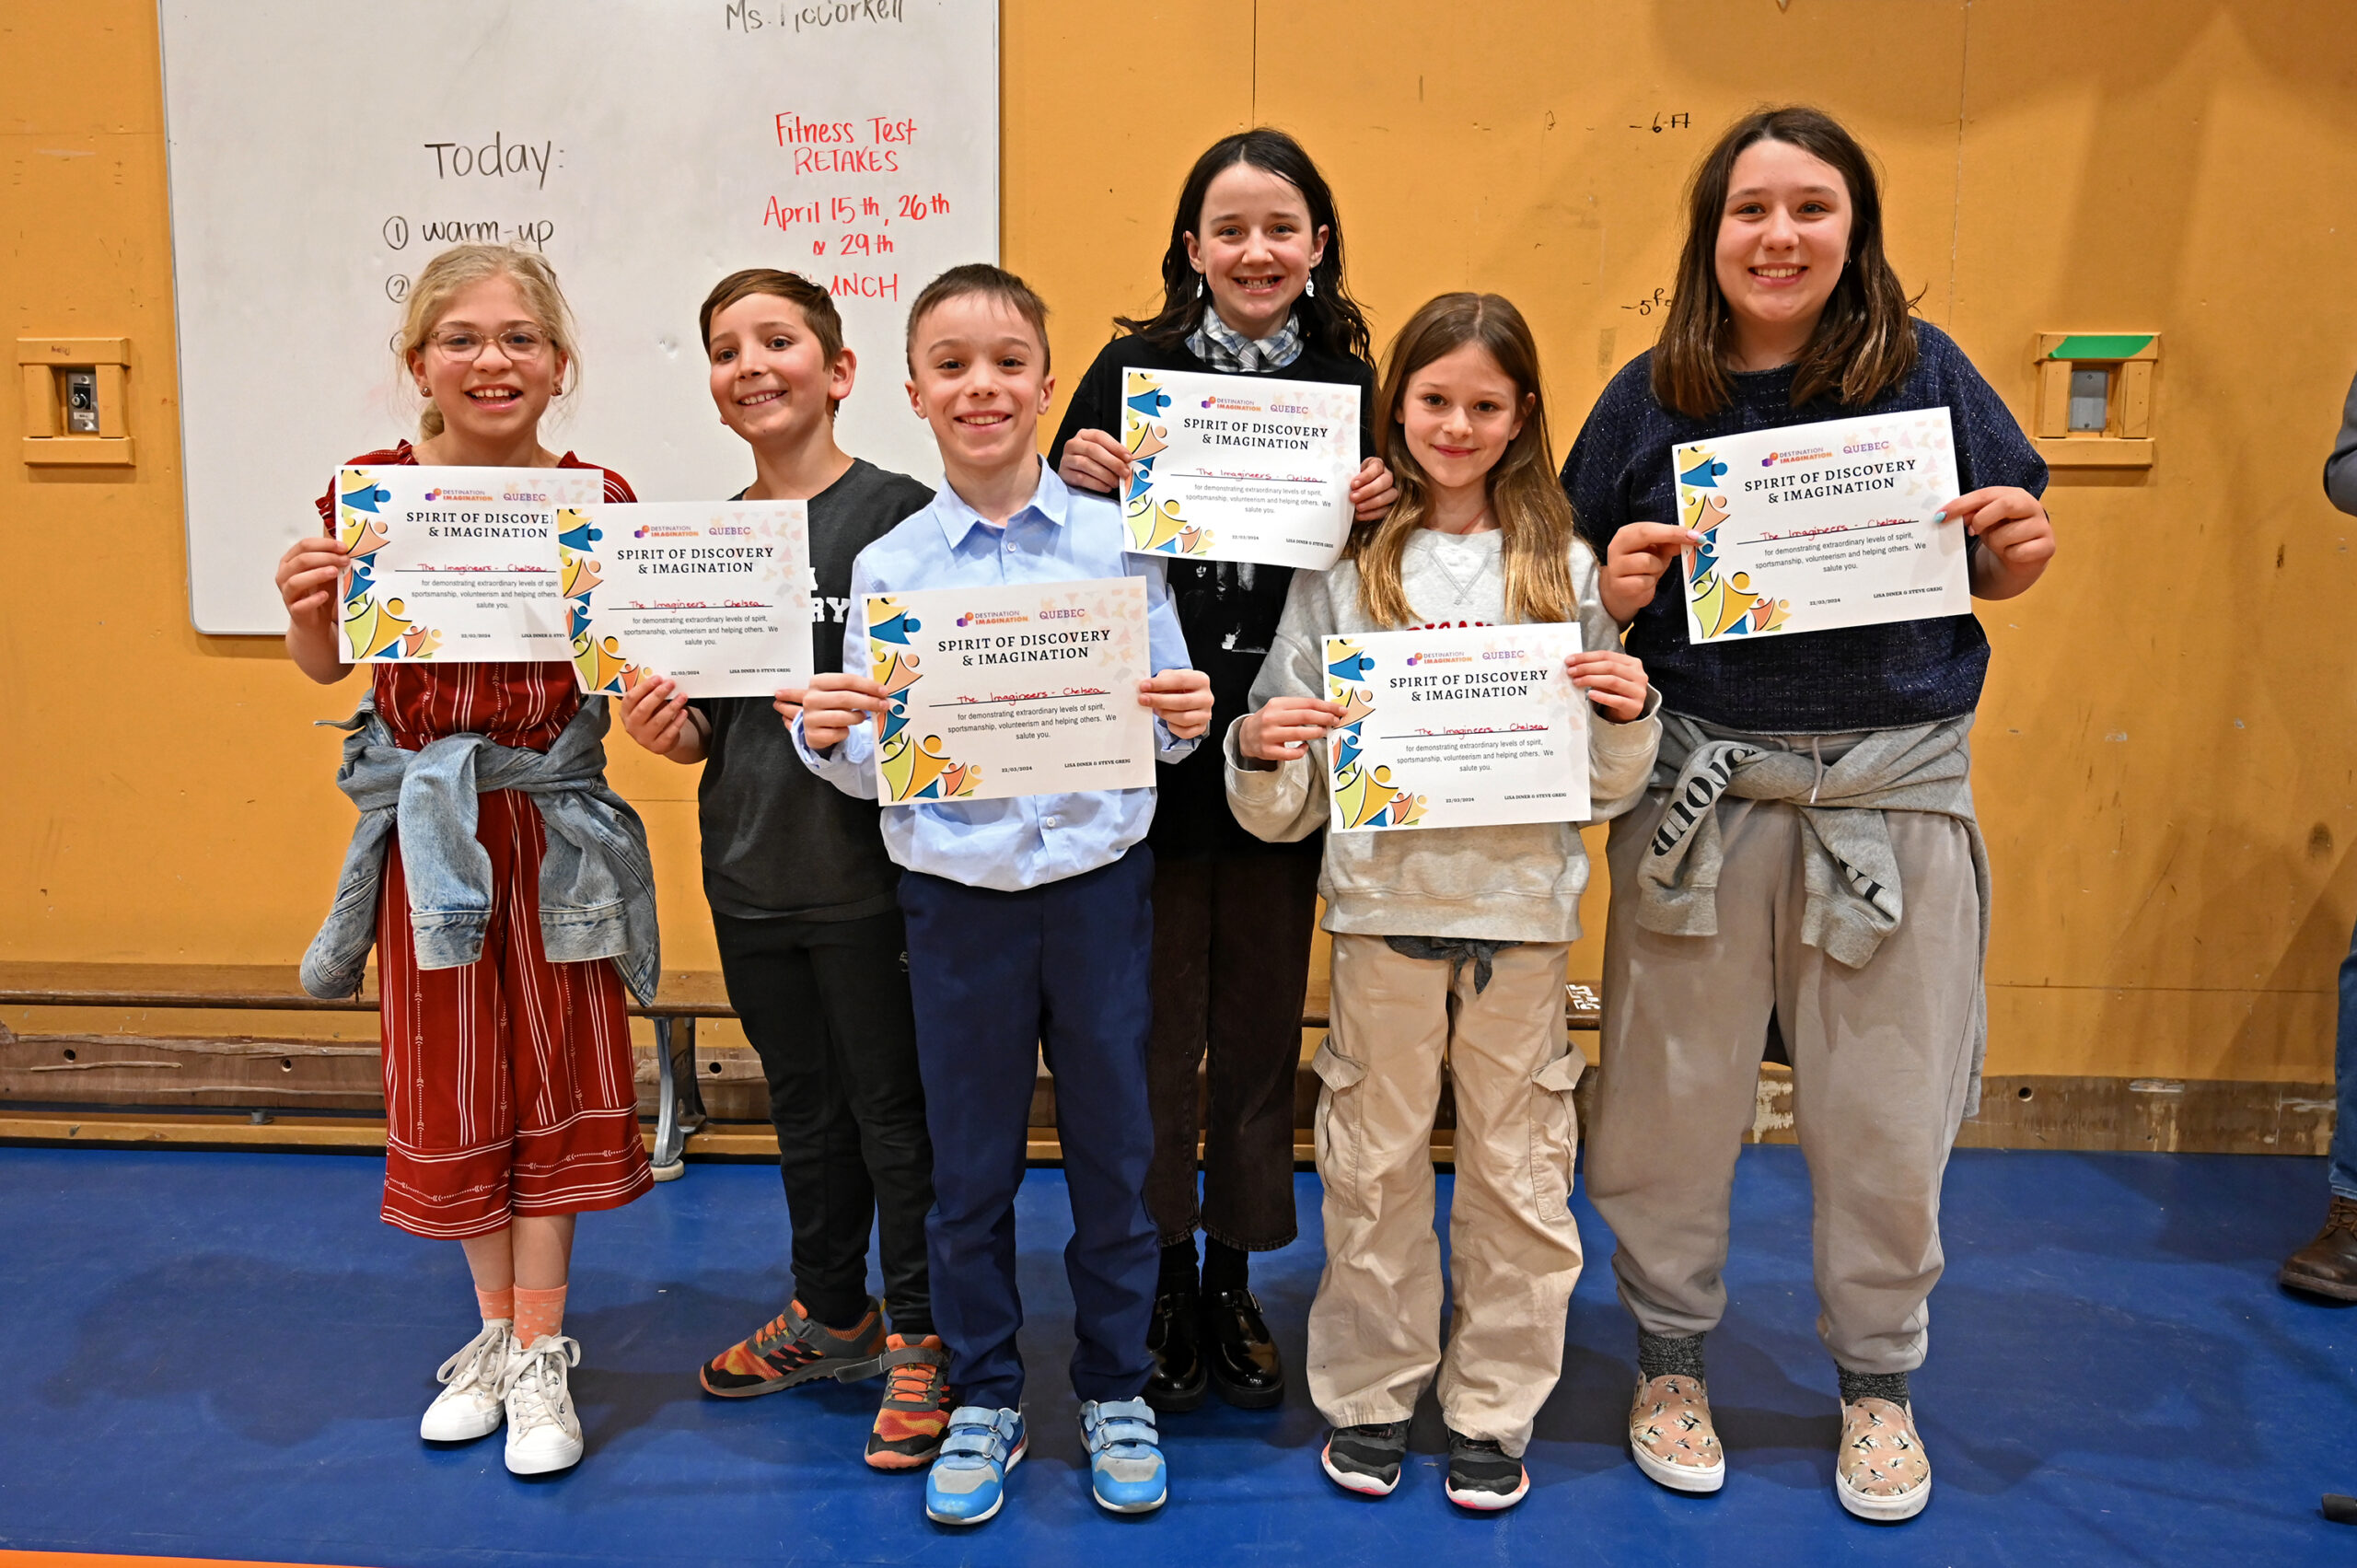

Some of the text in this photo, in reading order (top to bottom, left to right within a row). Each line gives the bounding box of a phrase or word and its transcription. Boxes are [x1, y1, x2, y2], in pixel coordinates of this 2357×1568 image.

[726, 0, 772, 32] Ms.
[775, 111, 918, 146] Fitness Test
[424, 132, 564, 190] Today:
[794, 145, 900, 175] RETAKES
[763, 195, 819, 231] April
[422, 218, 554, 250] warm-up
[1216, 397, 1254, 405] DESTINATION
[1216, 403, 1261, 412] IMAGINATION
[1270, 403, 1308, 414] QUEBEC
[1183, 417, 1328, 437] SPIRIT OF DISCOVERY
[1202, 433, 1308, 449] & IMAGINATION
[1842, 440, 1889, 454] QUEBEC
[1779, 447, 1824, 458] DESTINATION
[1780, 451, 1833, 464] IMAGINATION
[1744, 459, 1915, 492] SPIRIT OF DISCOVERY
[503, 491, 547, 503] QUEBEC
[1768, 476, 1894, 504] & IMAGINATION
[406, 511, 552, 524] SPIRIT OF DISCOVE
[428, 526, 547, 538] & IMAGINATION
[708, 526, 751, 536] QUEBEC
[1759, 517, 1911, 541] The Imagineers Chelsea
[1774, 543, 1821, 555] demonstrating
[1821, 538, 1865, 549] extraordinary
[1865, 534, 1886, 543] levels
[1887, 533, 1894, 541] of
[1895, 531, 1913, 540] spirit,
[617, 547, 773, 560] SPIRIT OF DISCOVERY
[1755, 557, 1804, 569] sportsmanship,
[1805, 552, 1847, 563] volunteerism
[1848, 549, 1861, 558] and
[1862, 547, 1887, 556] helping
[1887, 544, 1910, 553] others.
[638, 562, 753, 574] & IMAGINATION
[1822, 563, 1858, 573] salute you.
[628, 598, 766, 613] The Imagineers Chelsea
[974, 610, 1019, 619] DESTINATION
[974, 615, 1028, 625] IMAGINATION
[1039, 608, 1086, 620] QUEBEC
[937, 629, 1110, 652] SPIRIT OF DISCOVERY
[962, 646, 1088, 666] & IMAGINATION
[1422, 651, 1464, 659] DESTINATION
[1423, 656, 1472, 664] IMAGINATION
[1481, 649, 1525, 660] QUEBEC
[1389, 669, 1548, 688] SPIRIT OF DISCOVERY
[957, 686, 1105, 706] The Imagineers Chelsea
[1411, 685, 1527, 702] & IMAGINATION
[957, 703, 1105, 721] for demonstrating extraordinary levels of spirit,
[947, 722, 997, 734] sportsmanship,
[997, 720, 1039, 729] volunteerism
[1040, 717, 1053, 726] and
[1054, 716, 1079, 726] helping
[1079, 715, 1101, 724] others.
[1415, 723, 1550, 739] The Imagineers Chelsea
[1036, 731, 1051, 739] you.
[1415, 743, 1458, 751] demonstrating
[1458, 740, 1499, 749] extraordinary
[1499, 739, 1517, 748] levels
[1518, 738, 1525, 747] of
[1526, 738, 1543, 747] spirit,
[1396, 755, 1442, 764] sportsmanship,
[1443, 752, 1481, 761] volunteerism
[1482, 751, 1494, 760] and
[1495, 750, 1518, 759] helping
